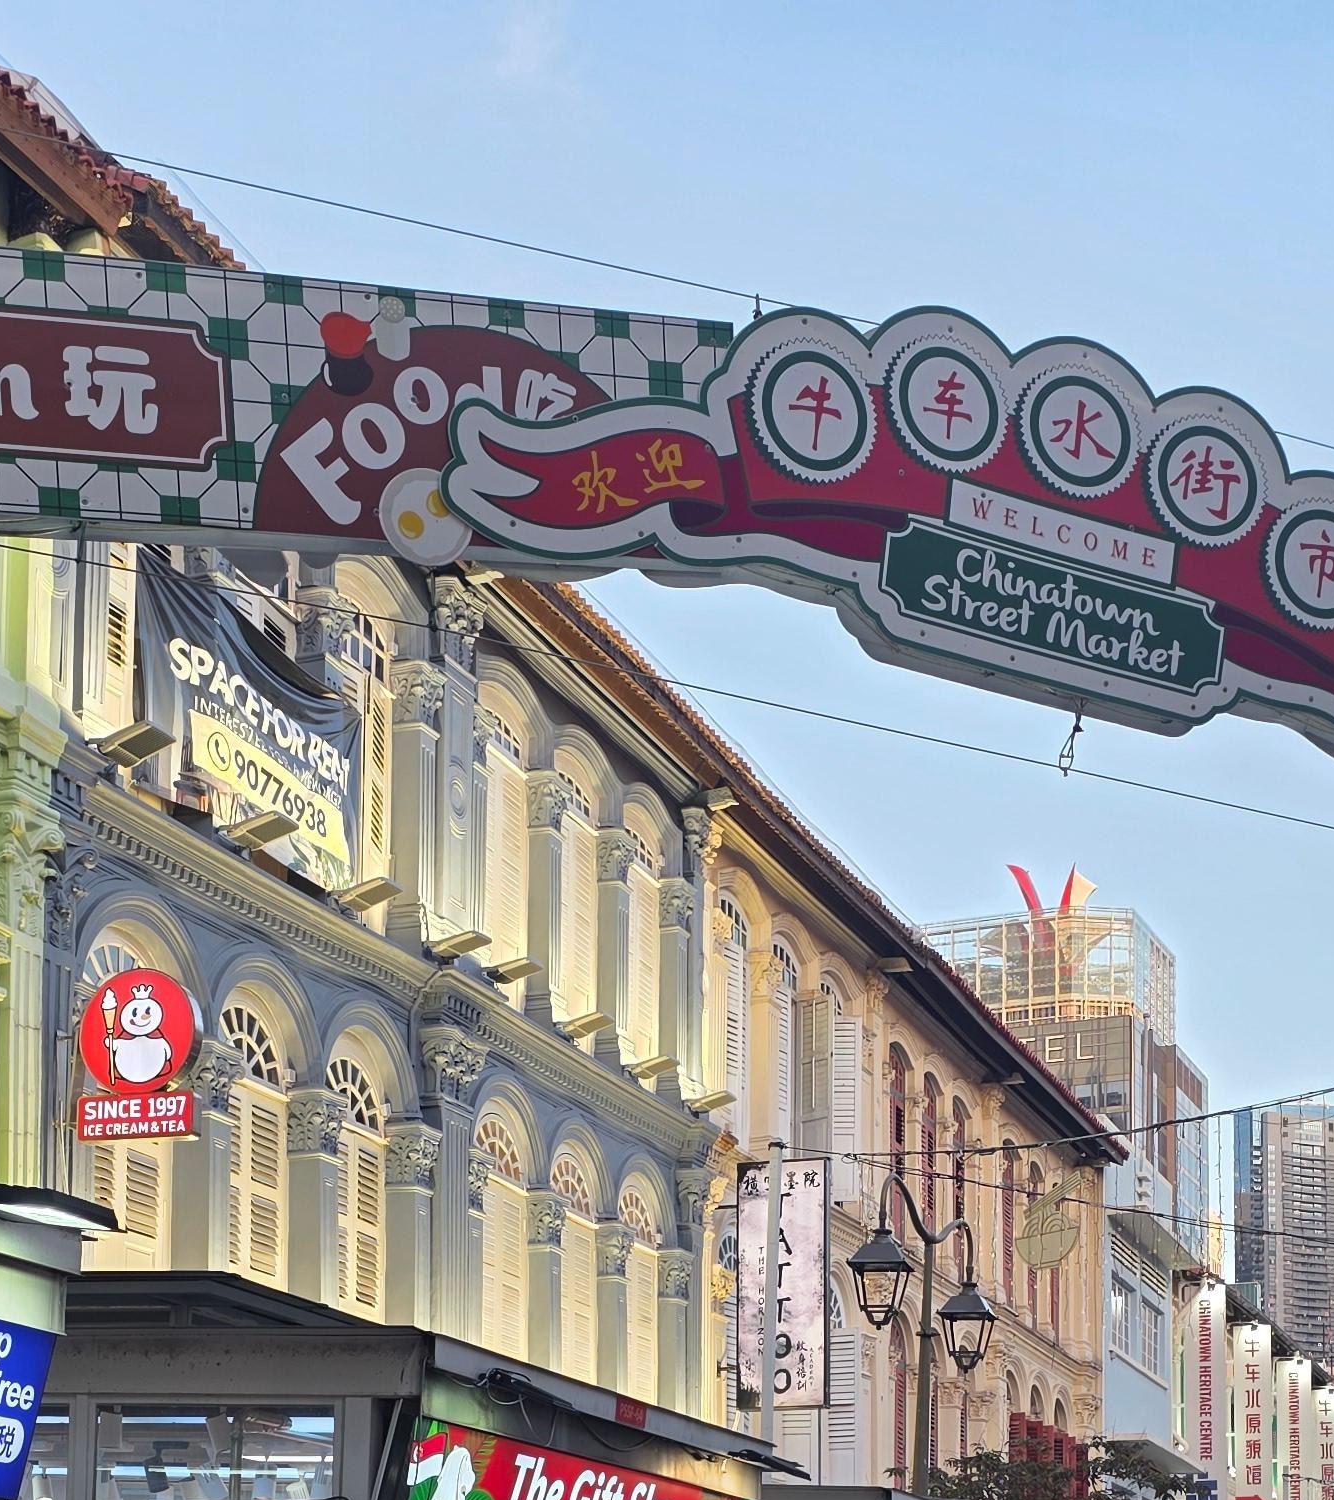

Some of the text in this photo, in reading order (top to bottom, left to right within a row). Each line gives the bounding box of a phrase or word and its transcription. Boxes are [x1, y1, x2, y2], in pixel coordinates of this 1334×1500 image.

[63, 345, 159, 435] 玩
[514, 369, 577, 421] 吃
[572, 438, 705, 515] 欢迎
[971, 496, 1156, 568] WELCOME
[920, 574, 1186, 677] Street Market
[955, 548, 1161, 637] Chinatown
[169, 637, 350, 796] SPACE FOR RENT
[234, 749, 327, 838] 90776938
[83, 1095, 187, 1120] SINCE 1997
[83, 1123, 104, 1137] ICE
[105, 1121, 148, 1136] CREAM
[757, 1286, 765, 1357] HORIZON
[1198, 1298, 1213, 1462] CHINATOWN HERITAGE CENTRE
[1244, 1337, 1262, 1486] 牛车水原貌馆
[1288, 1372, 1299, 1426] CHINATOWN
[1289, 1427, 1301, 1470] HERITAGE
